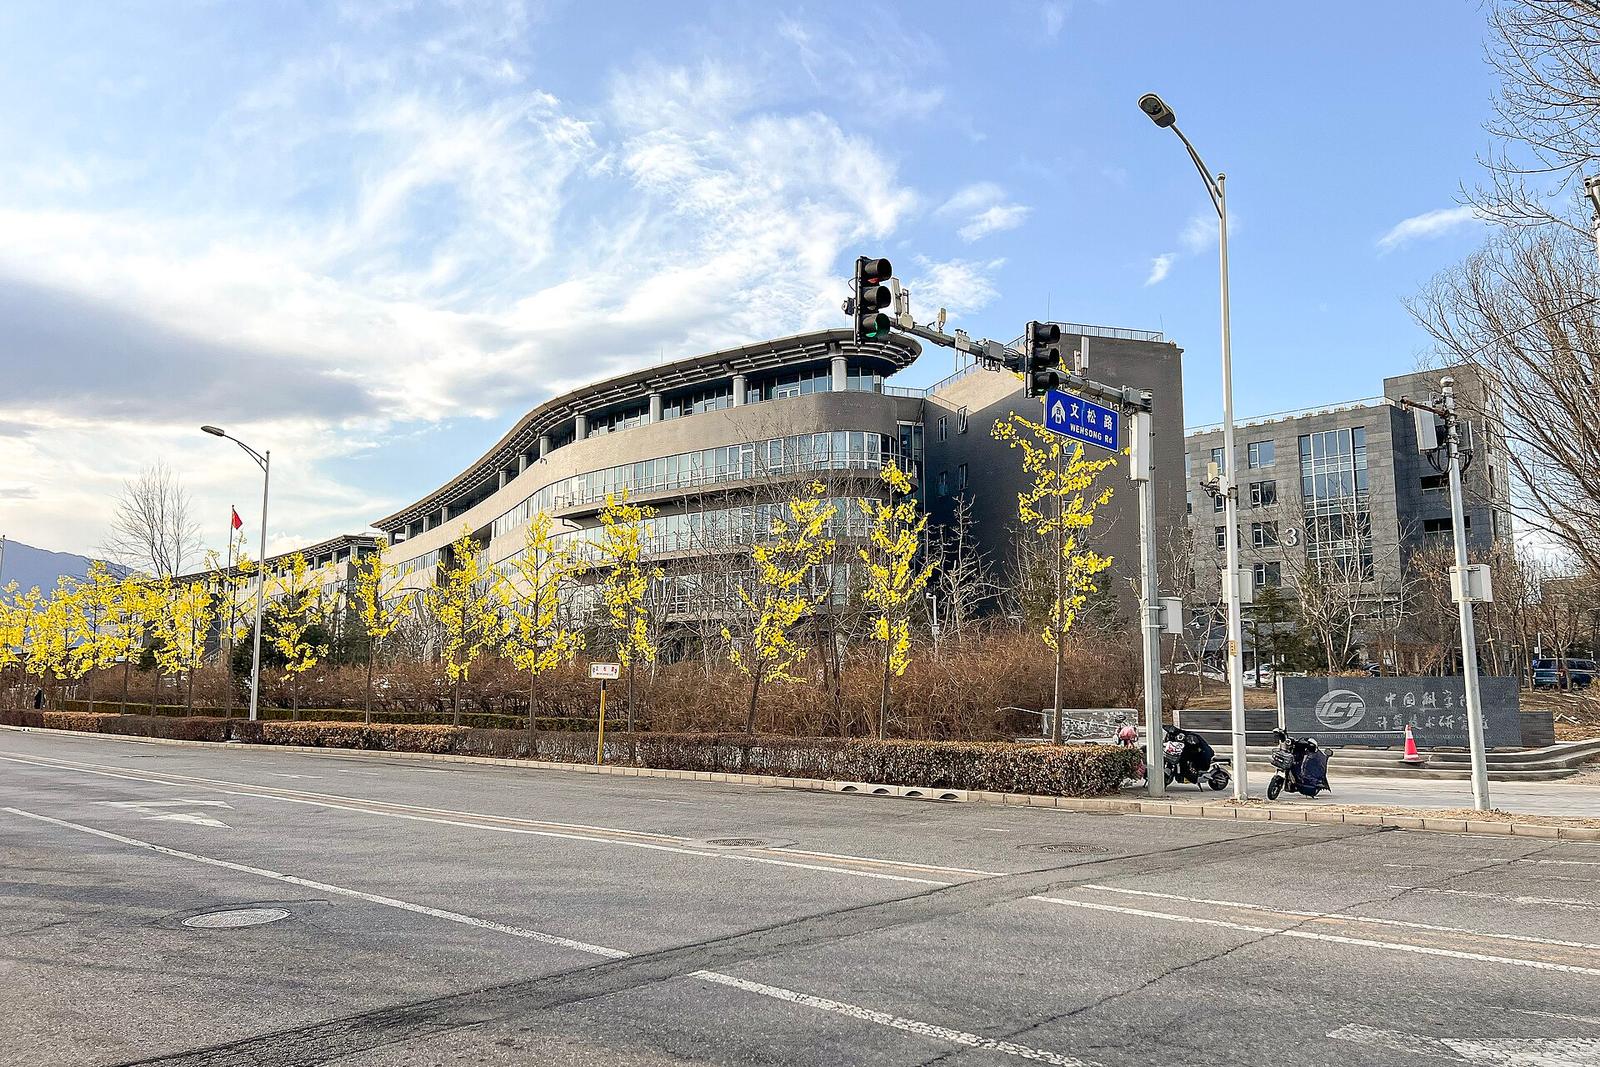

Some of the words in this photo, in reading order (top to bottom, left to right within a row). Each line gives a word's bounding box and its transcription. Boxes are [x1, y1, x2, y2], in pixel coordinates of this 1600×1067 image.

[1070, 402, 1113, 430] 文松路
[1070, 423, 1102, 440] WENSONG
[1104, 434, 1113, 444] Rd
[1285, 527, 1297, 546] 3
[1319, 702, 1364, 717] ICT
